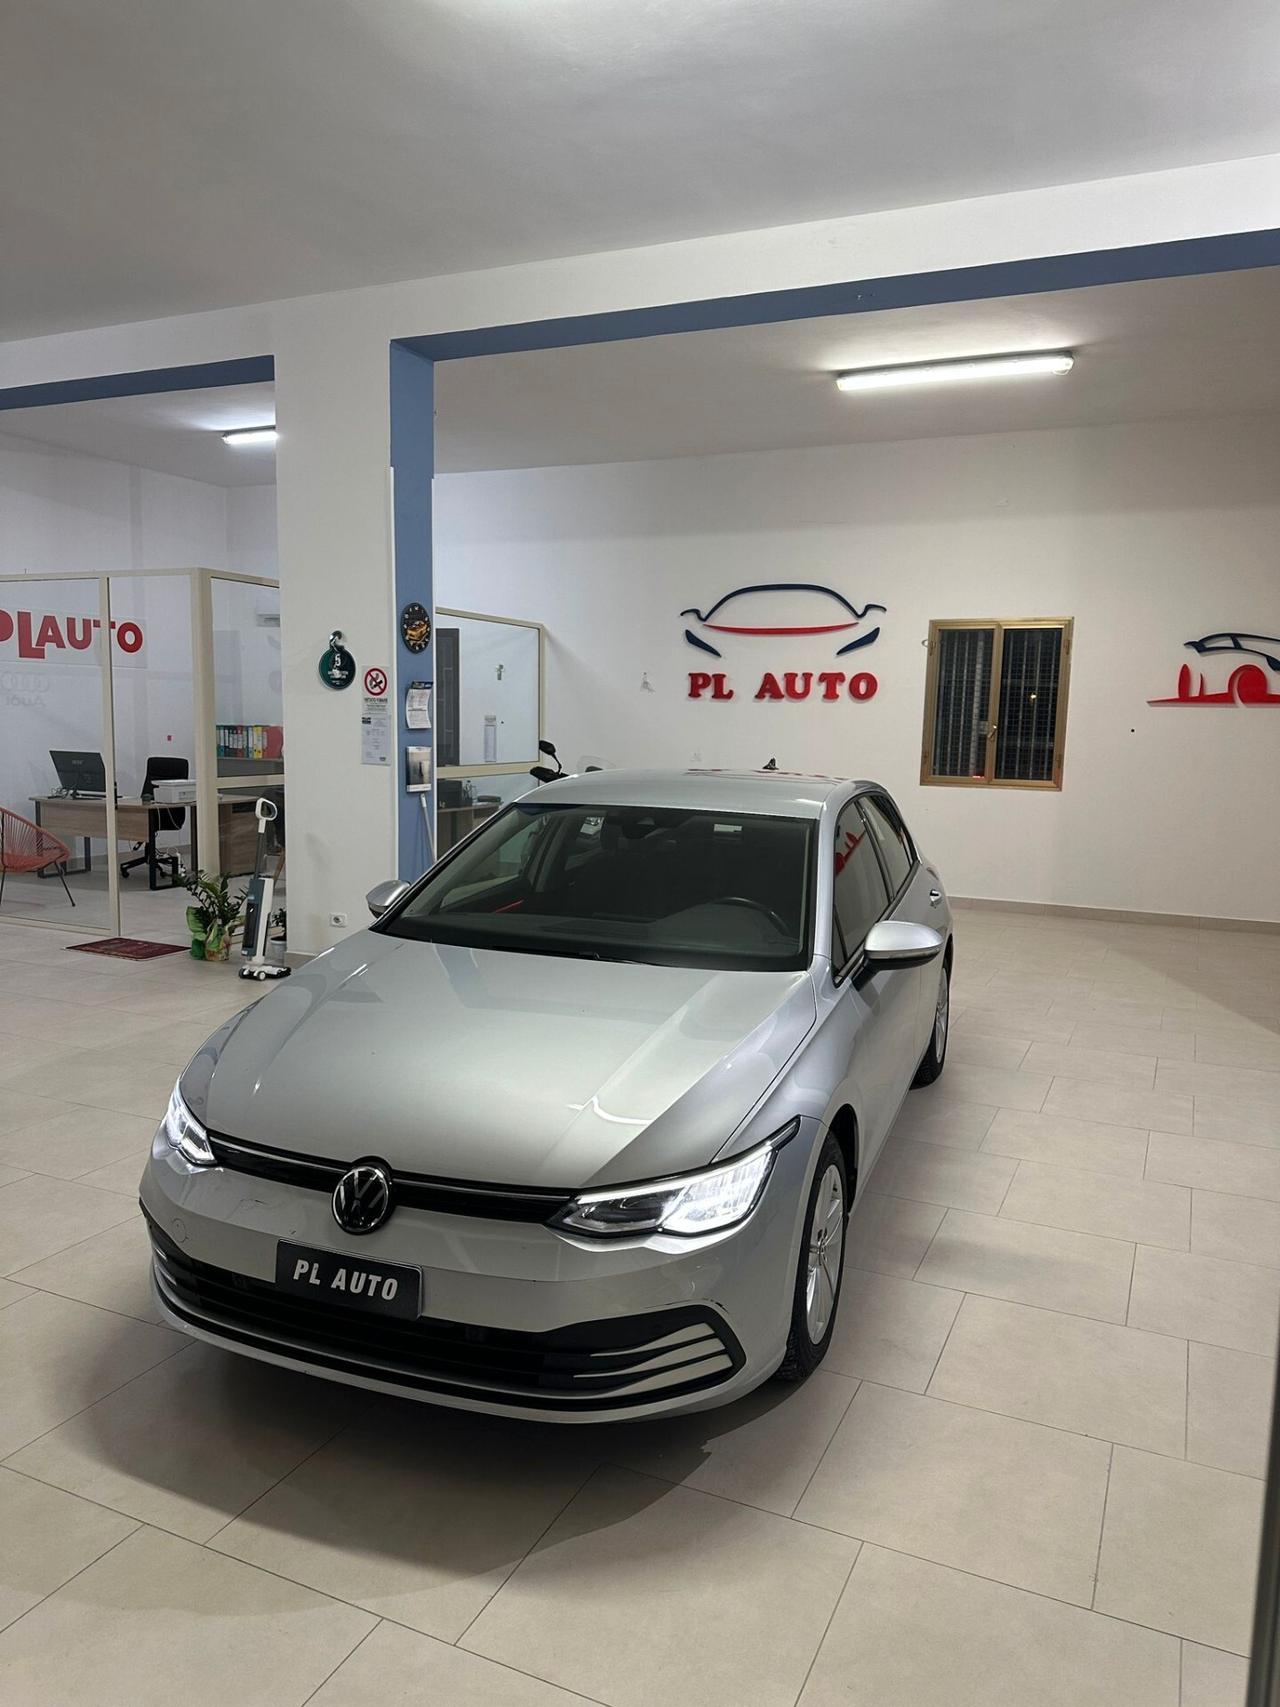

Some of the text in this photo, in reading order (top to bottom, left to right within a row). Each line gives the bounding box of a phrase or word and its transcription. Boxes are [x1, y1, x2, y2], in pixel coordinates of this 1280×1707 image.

[334, 653, 342, 667] 5
[688, 672, 878, 700] PL AUTO
[293, 1259, 398, 1301] PL AUTO
